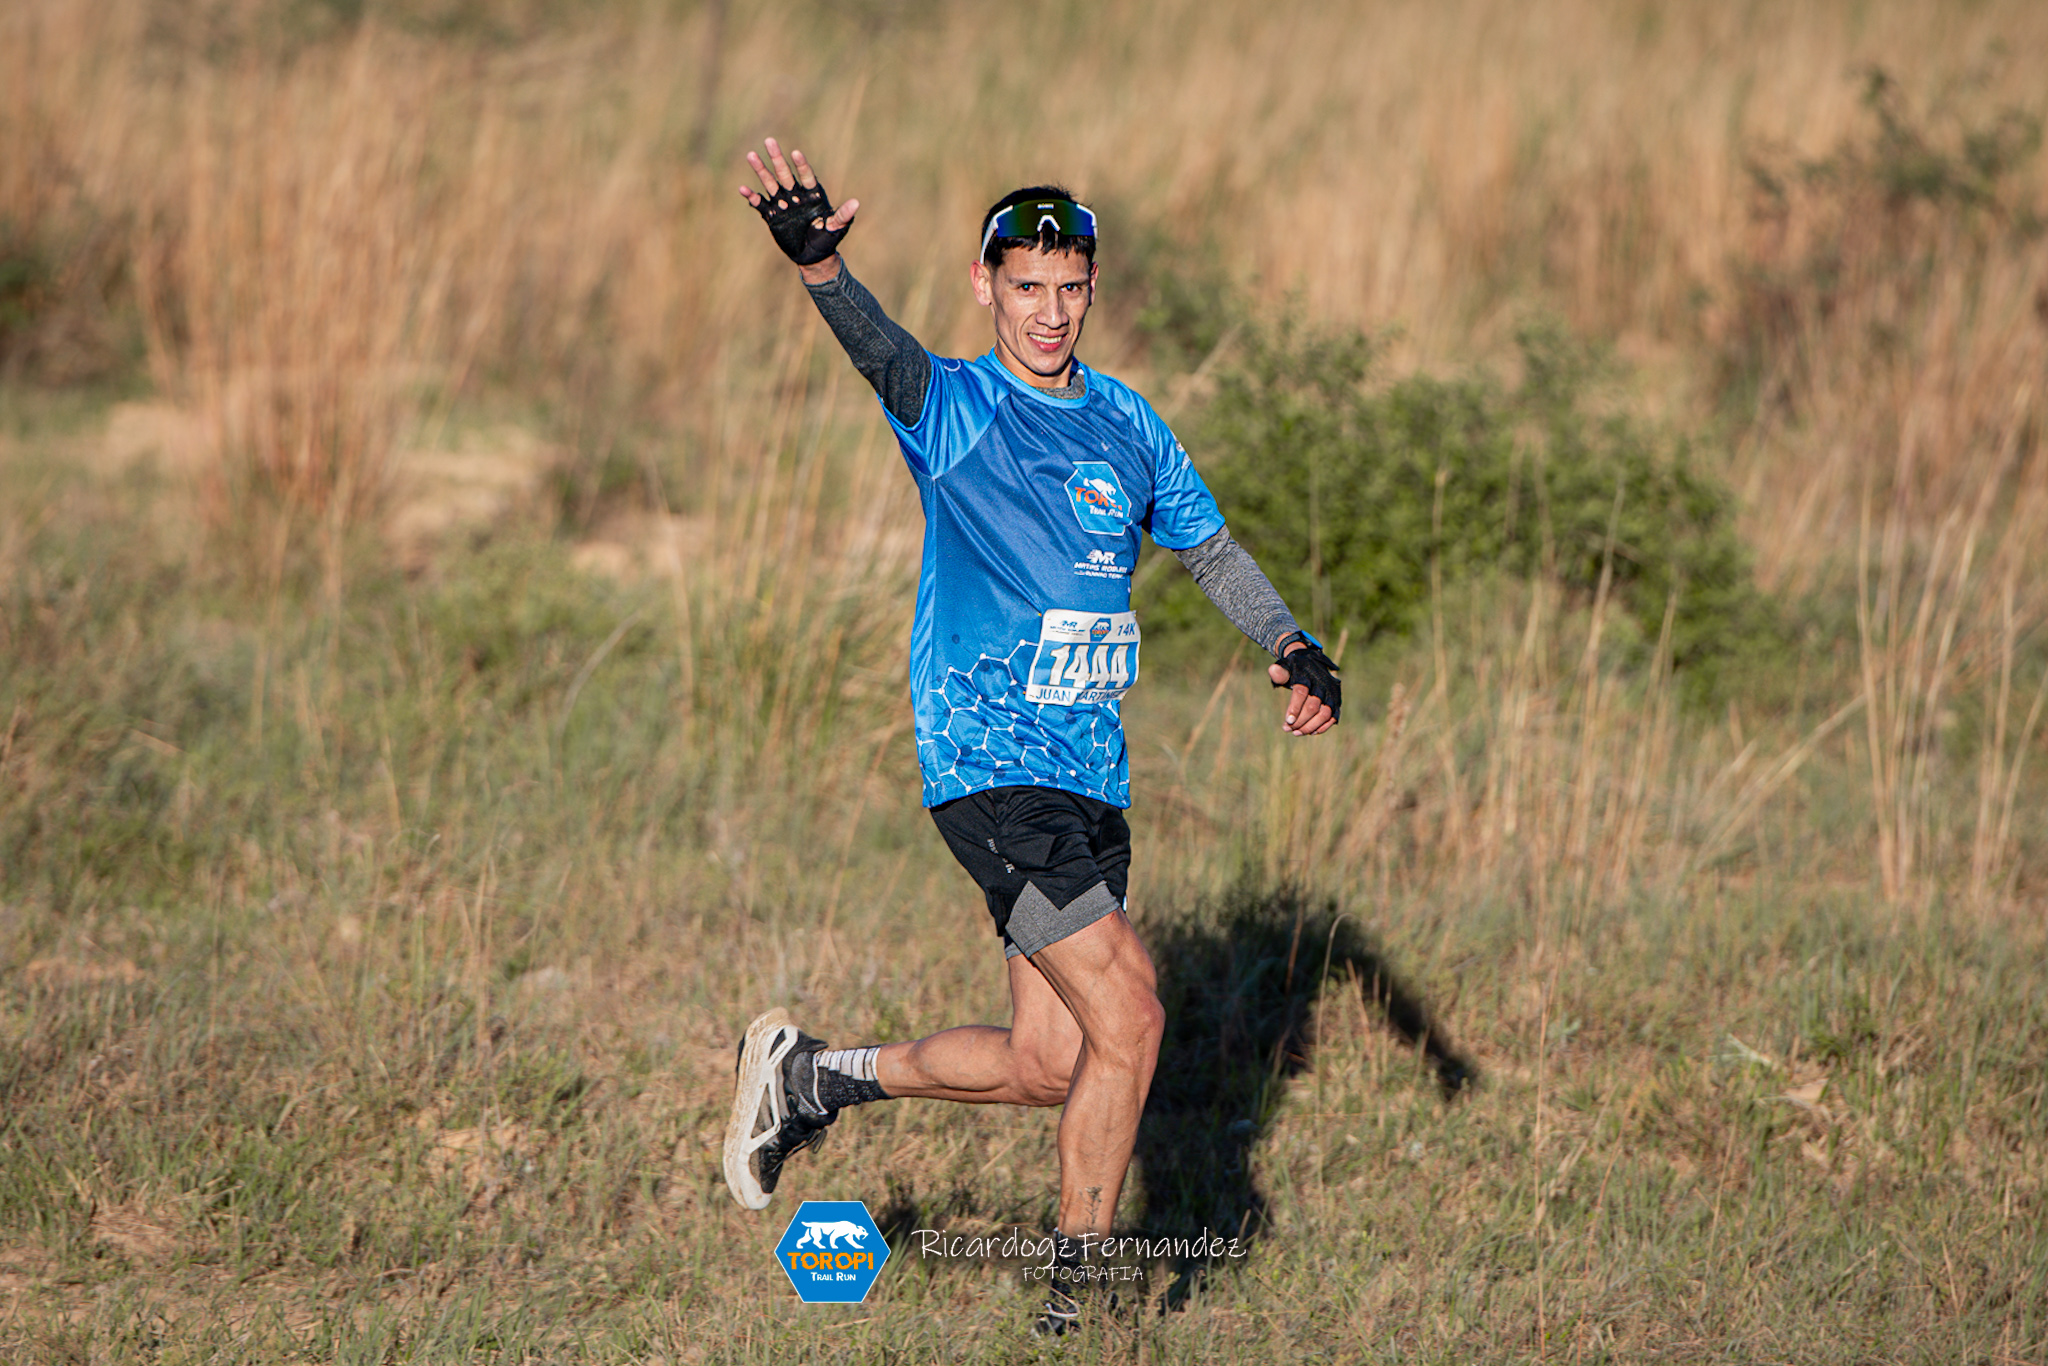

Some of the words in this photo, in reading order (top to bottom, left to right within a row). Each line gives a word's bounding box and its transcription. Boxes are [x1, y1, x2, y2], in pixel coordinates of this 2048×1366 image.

[1117, 622, 1136, 636] 14K
[1049, 644, 1129, 689] 1444
[1036, 688, 1071, 702] JUAN
